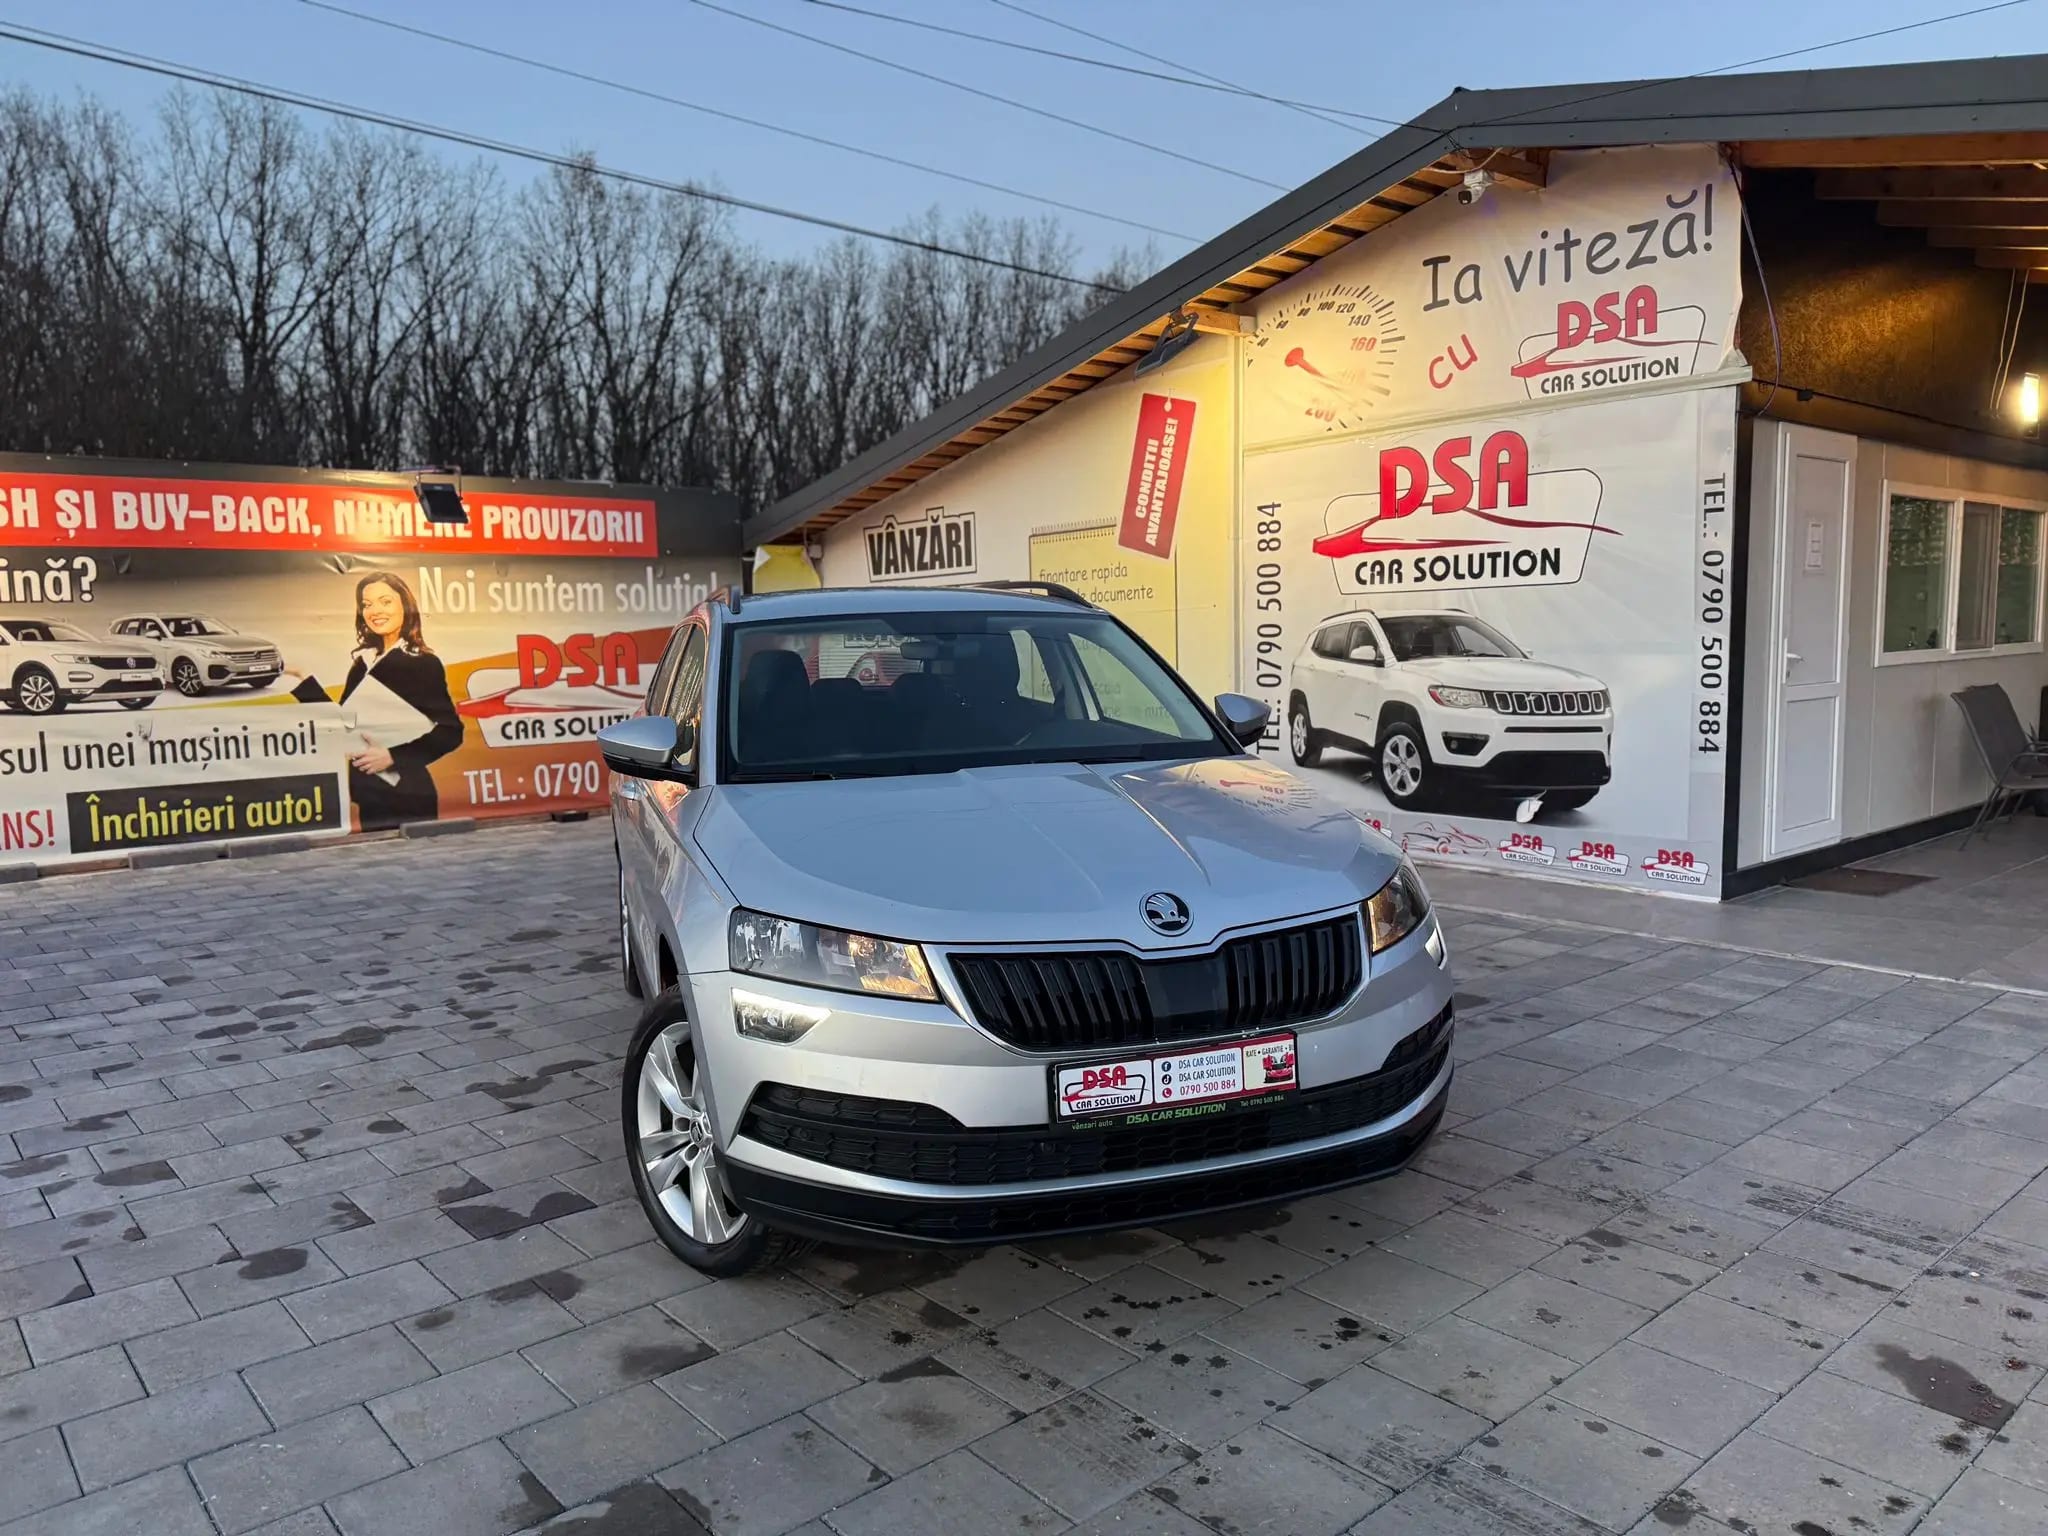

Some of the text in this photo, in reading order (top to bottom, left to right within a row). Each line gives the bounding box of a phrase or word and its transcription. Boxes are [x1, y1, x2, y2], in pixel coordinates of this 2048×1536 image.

[1423, 183, 1714, 312] Ia viteză!
[1317, 300, 1335, 311] 100
[1336, 302, 1356, 313] 120
[1348, 314, 1372, 327] 140
[1556, 284, 1658, 351] DSA
[1350, 337, 1377, 351] 160
[1428, 334, 1479, 390] cu
[1540, 356, 1680, 395] CAR SOLUTION
[1145, 417, 1179, 547] AVANTAJOASE!
[1379, 429, 1529, 520] DSA
[54, 488, 97, 539] ȘI
[112, 490, 322, 536] BUY-BACK,
[482, 505, 644, 543] PROVIZORII
[1256, 502, 1282, 553] 884
[868, 515, 973, 575] VÂNZĂRI
[1091, 562, 1128, 583] rapida
[1354, 547, 1561, 586] CAR SOLUTION
[419, 566, 475, 613] Noi
[488, 575, 604, 613] suntem
[1090, 587, 1154, 603] documente
[1256, 563, 1282, 612] 500
[1698, 472, 1726, 754] TEL.: 0790 500 884
[516, 632, 640, 689] DSA
[1256, 623, 1282, 688] 0790
[500, 714, 630, 741] CAR SOLUT
[0, 720, 318, 775] sul unei mașini noi!
[463, 762, 600, 805] TEL.: 0790
[0, 786, 324, 851] NS! Închirieri auto!
[1511, 833, 1543, 851] DSA
[1582, 841, 1616, 860] DSA
[1657, 849, 1695, 868] DSA
[1589, 864, 1622, 874] SOLUTION
[1666, 873, 1701, 883] SOLUTION
[1082, 1065, 1127, 1090] DSA
[1178, 1053, 1236, 1070] DSA CAR SOLUTION
[1178, 1066, 1236, 1082] DSA CAR SOLUTION
[1076, 1094, 1136, 1109] CAR SOLUTION
[1180, 1079, 1236, 1096] 0790 500 884
[1126, 1102, 1227, 1125] DSA CAR SOLUTION
